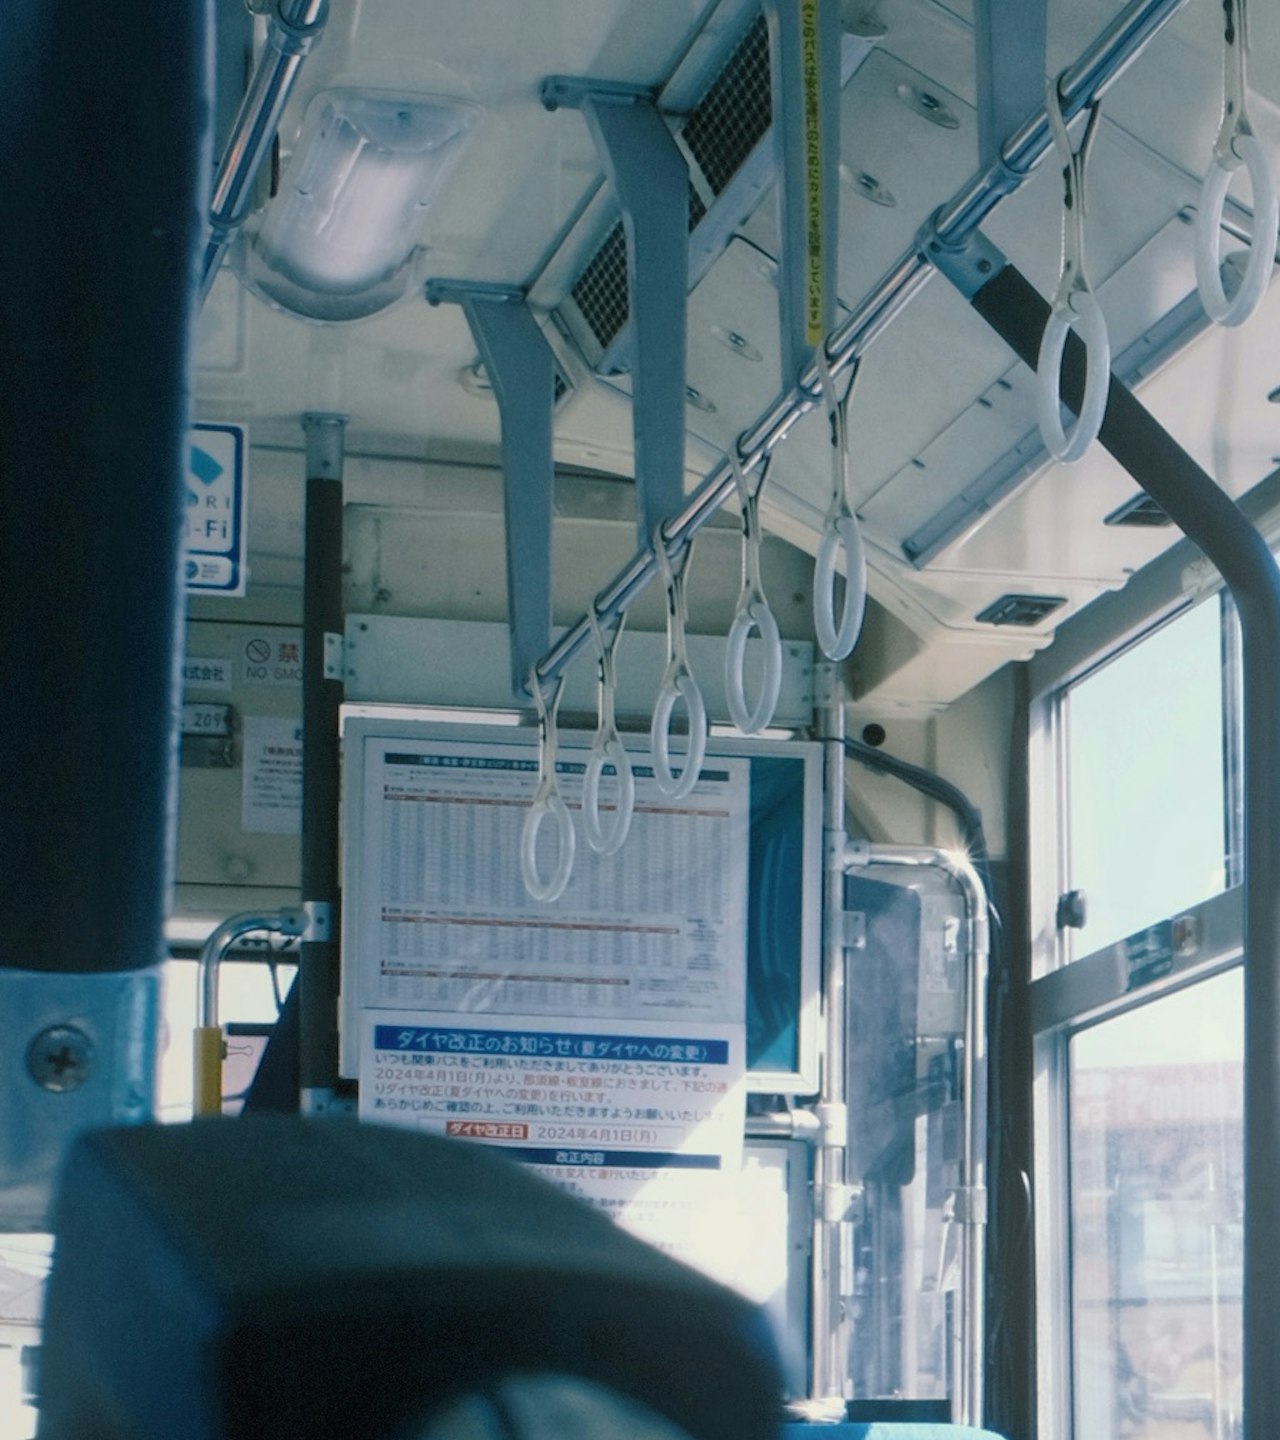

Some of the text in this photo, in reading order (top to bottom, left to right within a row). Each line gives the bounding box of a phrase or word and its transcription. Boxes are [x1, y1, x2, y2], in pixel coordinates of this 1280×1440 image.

[245, 666, 268, 680] NO
[398, 1025, 708, 1062] ダイヤ改正のお知らせ(夏ダイヤへの変更)
[375, 1053, 709, 1079] いつも関東バスをご利用いただきましてありがとうございます。
[449, 1122, 660, 1145] ダイヤ改正日 2024年4月1日(月)
[555, 1150, 606, 1166] 改正内容
